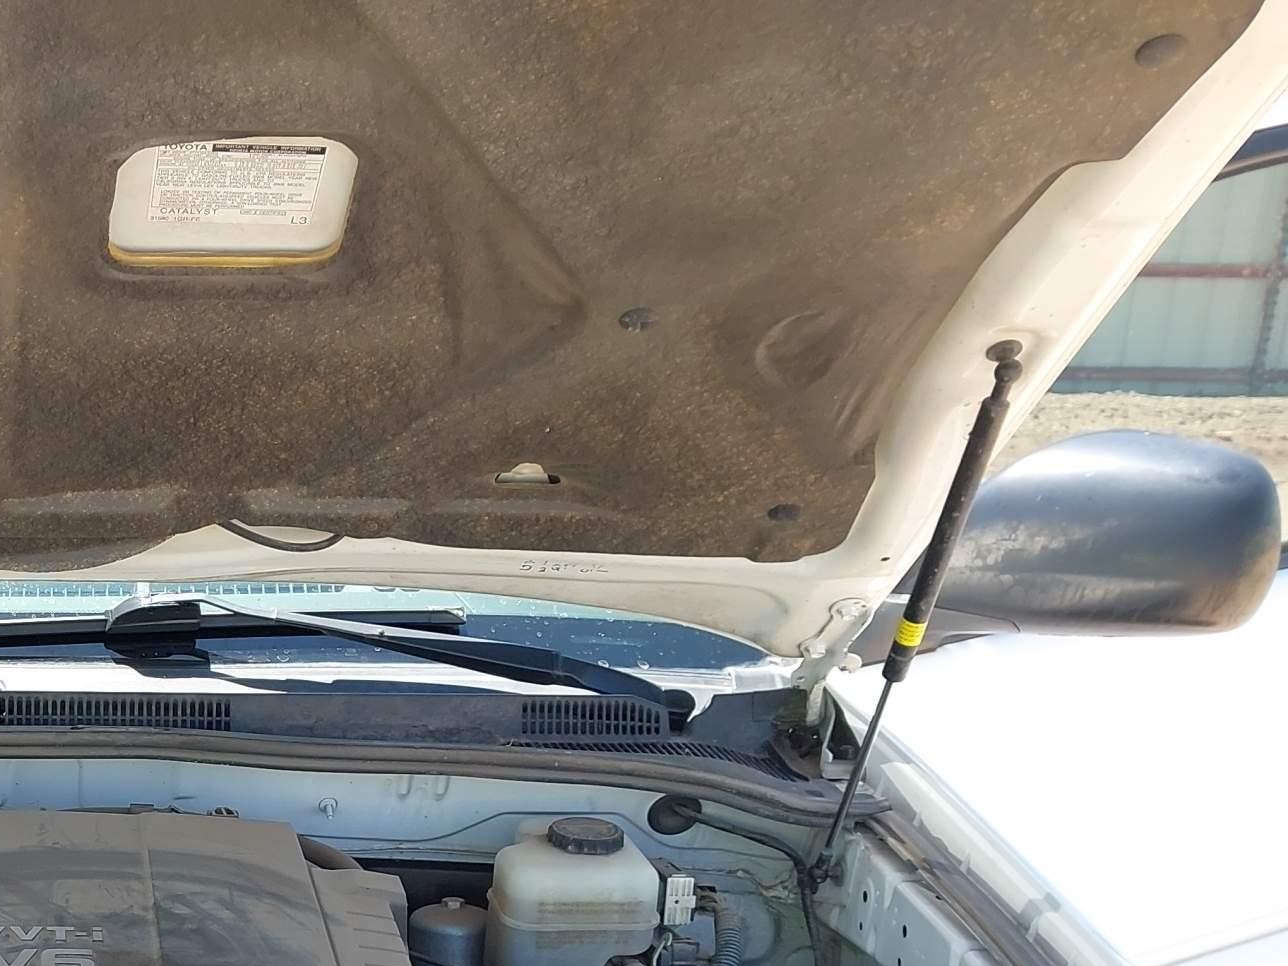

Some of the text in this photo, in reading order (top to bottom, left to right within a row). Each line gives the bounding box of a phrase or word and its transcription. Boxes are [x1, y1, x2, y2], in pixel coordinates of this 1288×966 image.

[163, 143, 208, 151] TOYOTA
[160, 207, 218, 215] CATALYST
[290, 216, 308, 225] L3
